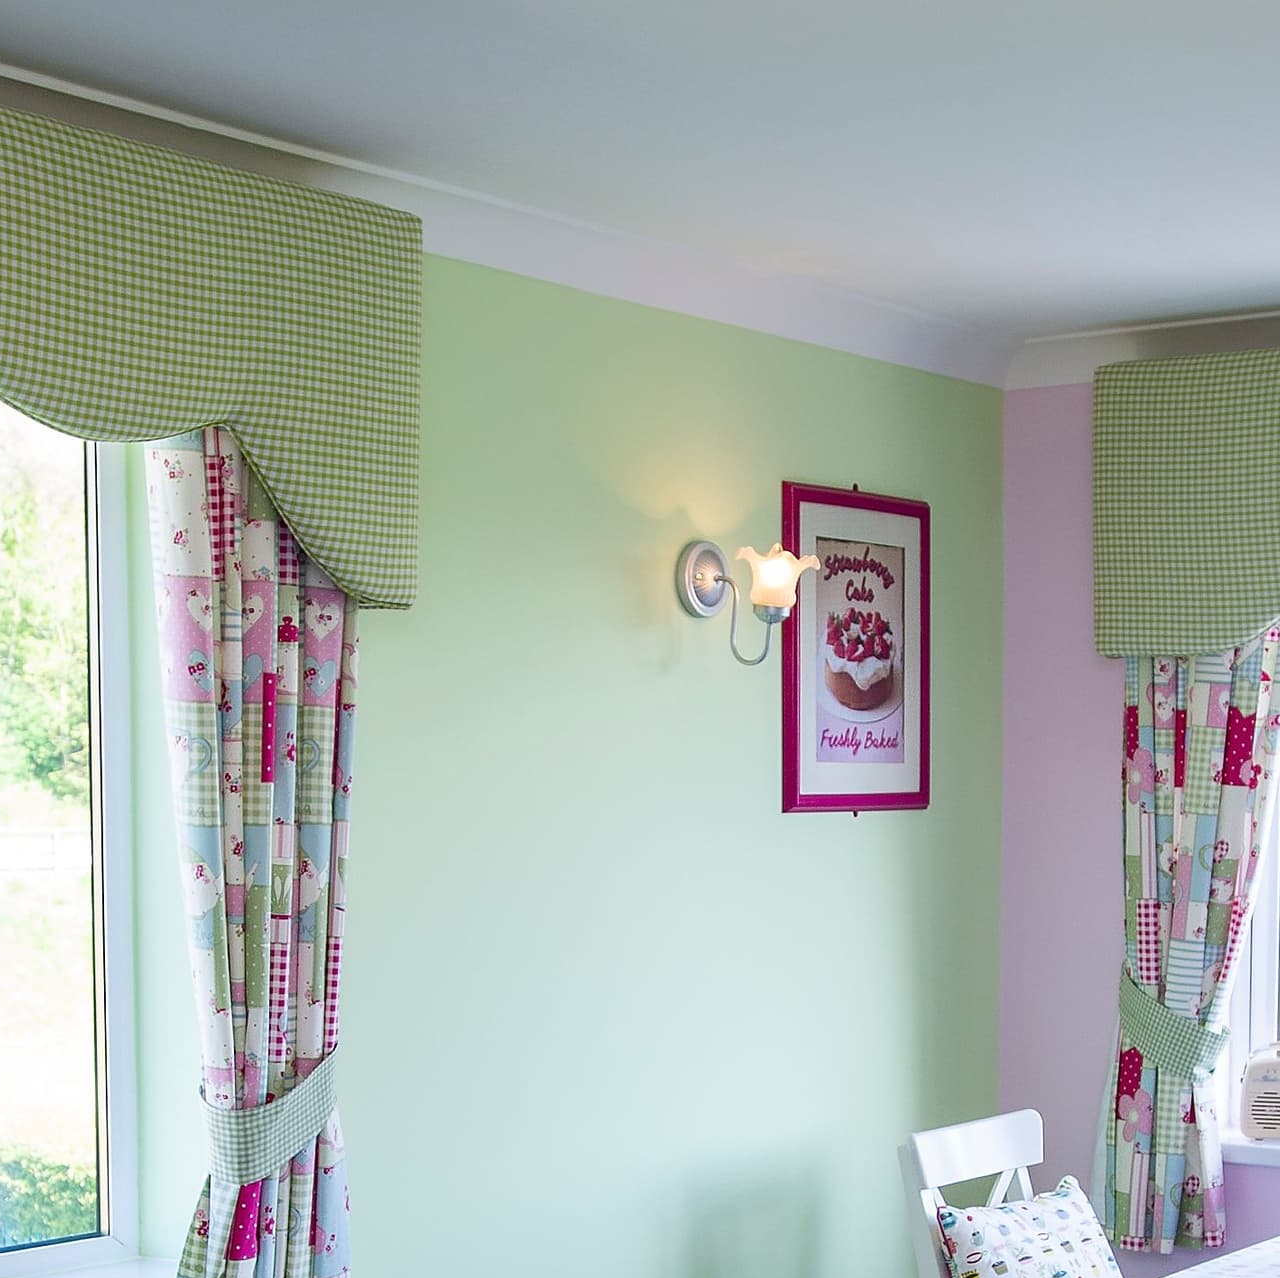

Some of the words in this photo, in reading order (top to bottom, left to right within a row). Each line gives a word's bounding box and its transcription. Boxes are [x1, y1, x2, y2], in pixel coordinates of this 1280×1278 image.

[846, 576, 874, 603] Cake
[820, 727, 861, 756] Freshly
[864, 728, 899, 749] Baked
